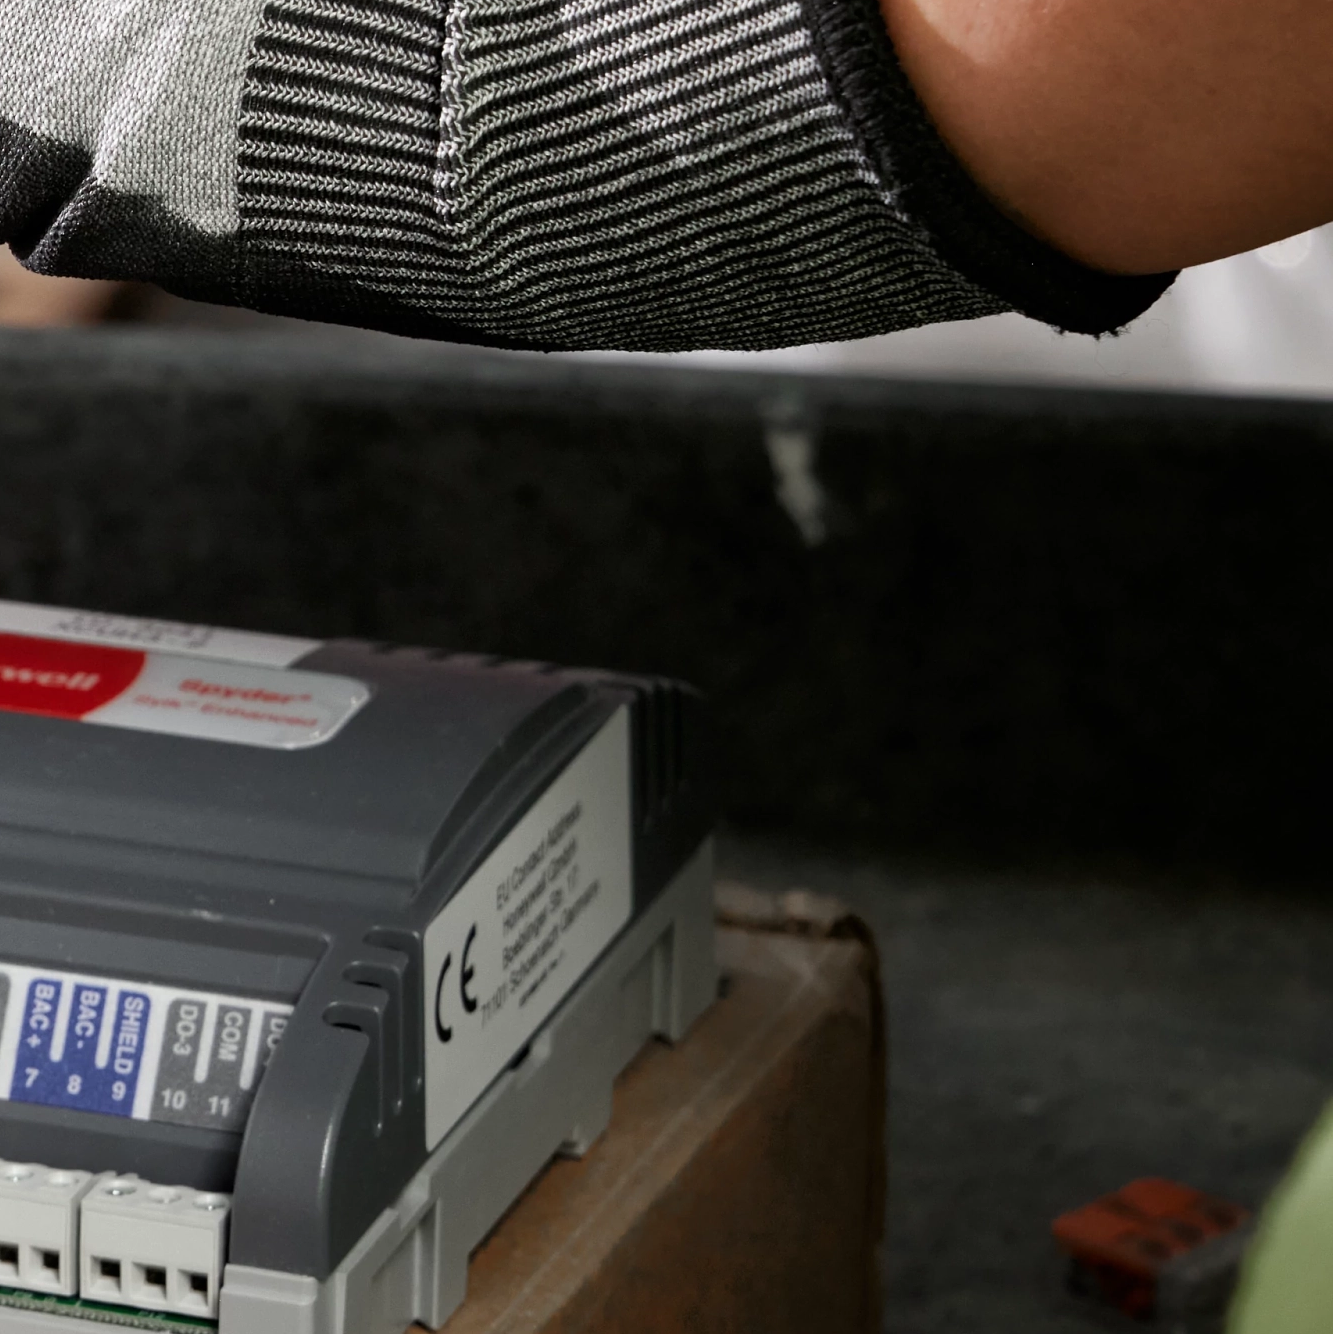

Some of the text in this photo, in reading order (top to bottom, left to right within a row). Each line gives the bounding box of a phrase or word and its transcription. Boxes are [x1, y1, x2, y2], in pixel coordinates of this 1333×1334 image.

[29, 983, 56, 1032] BAC
[75, 989, 101, 1038] BAC
[173, 1004, 198, 1056] DO-3
[114, 996, 145, 1075] SHIELD
[217, 1011, 244, 1062] COM
[24, 1067, 126, 1102] 7 8 9
[161, 1089, 230, 1117] 10 11
